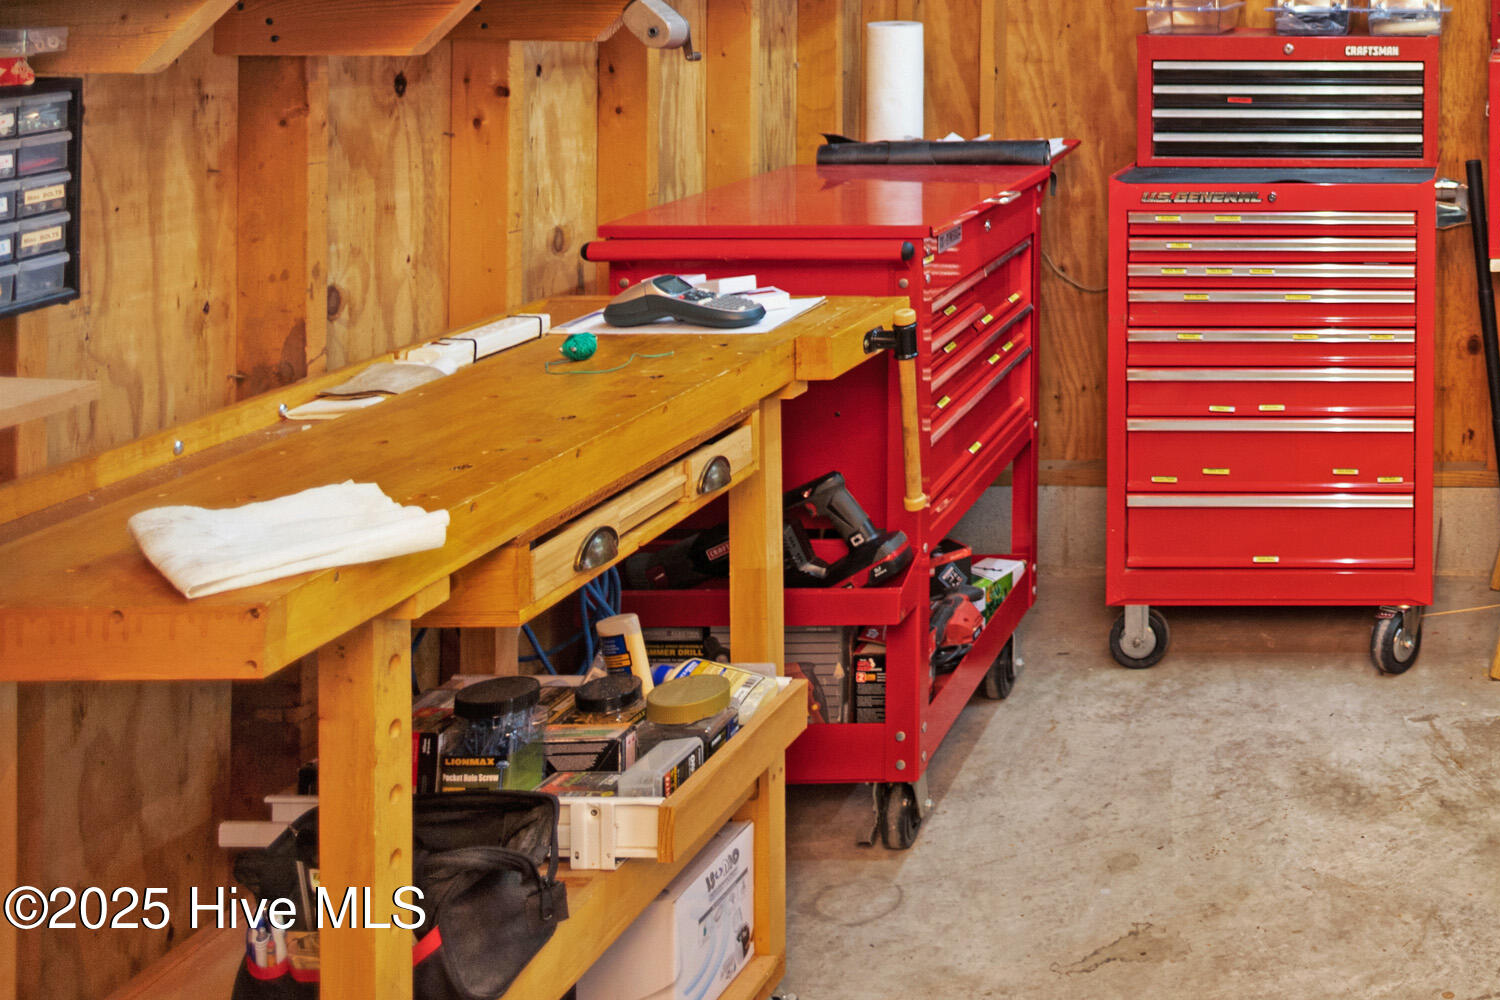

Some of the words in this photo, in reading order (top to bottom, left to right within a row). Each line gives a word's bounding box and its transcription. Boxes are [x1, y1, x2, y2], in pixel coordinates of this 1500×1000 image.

[1345, 46, 1399, 56] CRAFTSMAN
[1174, 191, 1262, 203] GENERAL
[444, 758, 495, 766] LIONMAX
